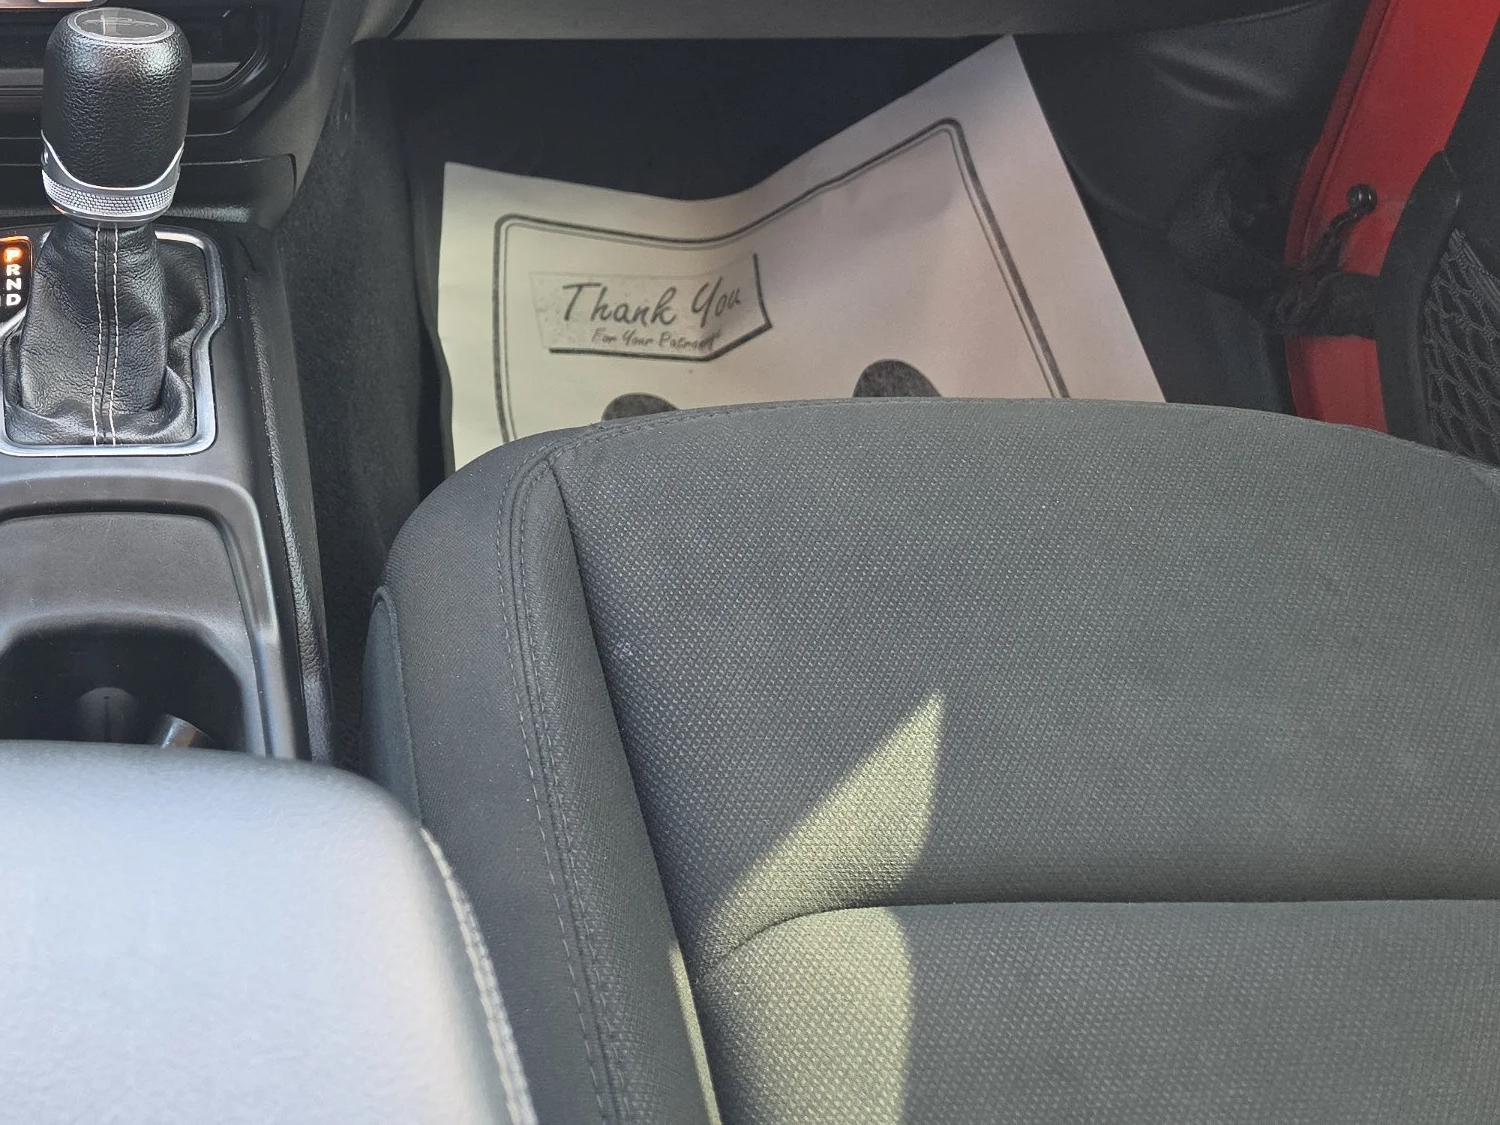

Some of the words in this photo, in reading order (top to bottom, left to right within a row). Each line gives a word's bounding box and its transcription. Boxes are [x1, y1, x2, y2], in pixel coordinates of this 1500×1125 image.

[5, 249, 21, 262] P
[6, 264, 21, 276] R
[6, 278, 22, 291] N
[6, 294, 21, 306] D
[562, 282, 677, 327] Thank
[691, 276, 740, 327] You
[591, 327, 617, 343] For
[622, 330, 654, 346] Your
